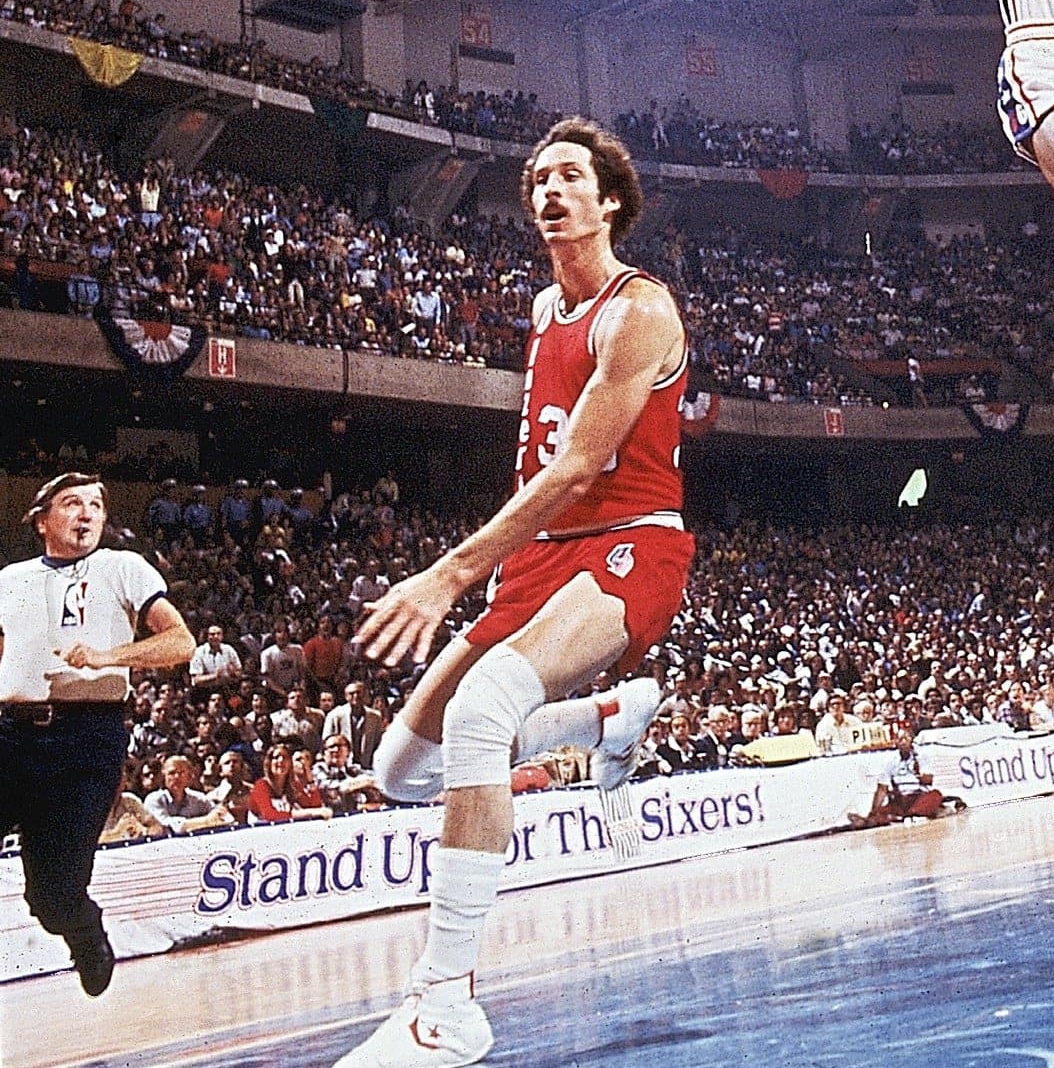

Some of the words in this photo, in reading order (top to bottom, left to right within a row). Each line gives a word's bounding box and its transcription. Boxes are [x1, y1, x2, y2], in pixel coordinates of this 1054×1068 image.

[957, 748, 1028, 791] Stand
[196, 832, 365, 914] Stand
[382, 830, 442, 894] Up
[547, 805, 607, 857] Th
[639, 783, 767, 844] Sixers!
